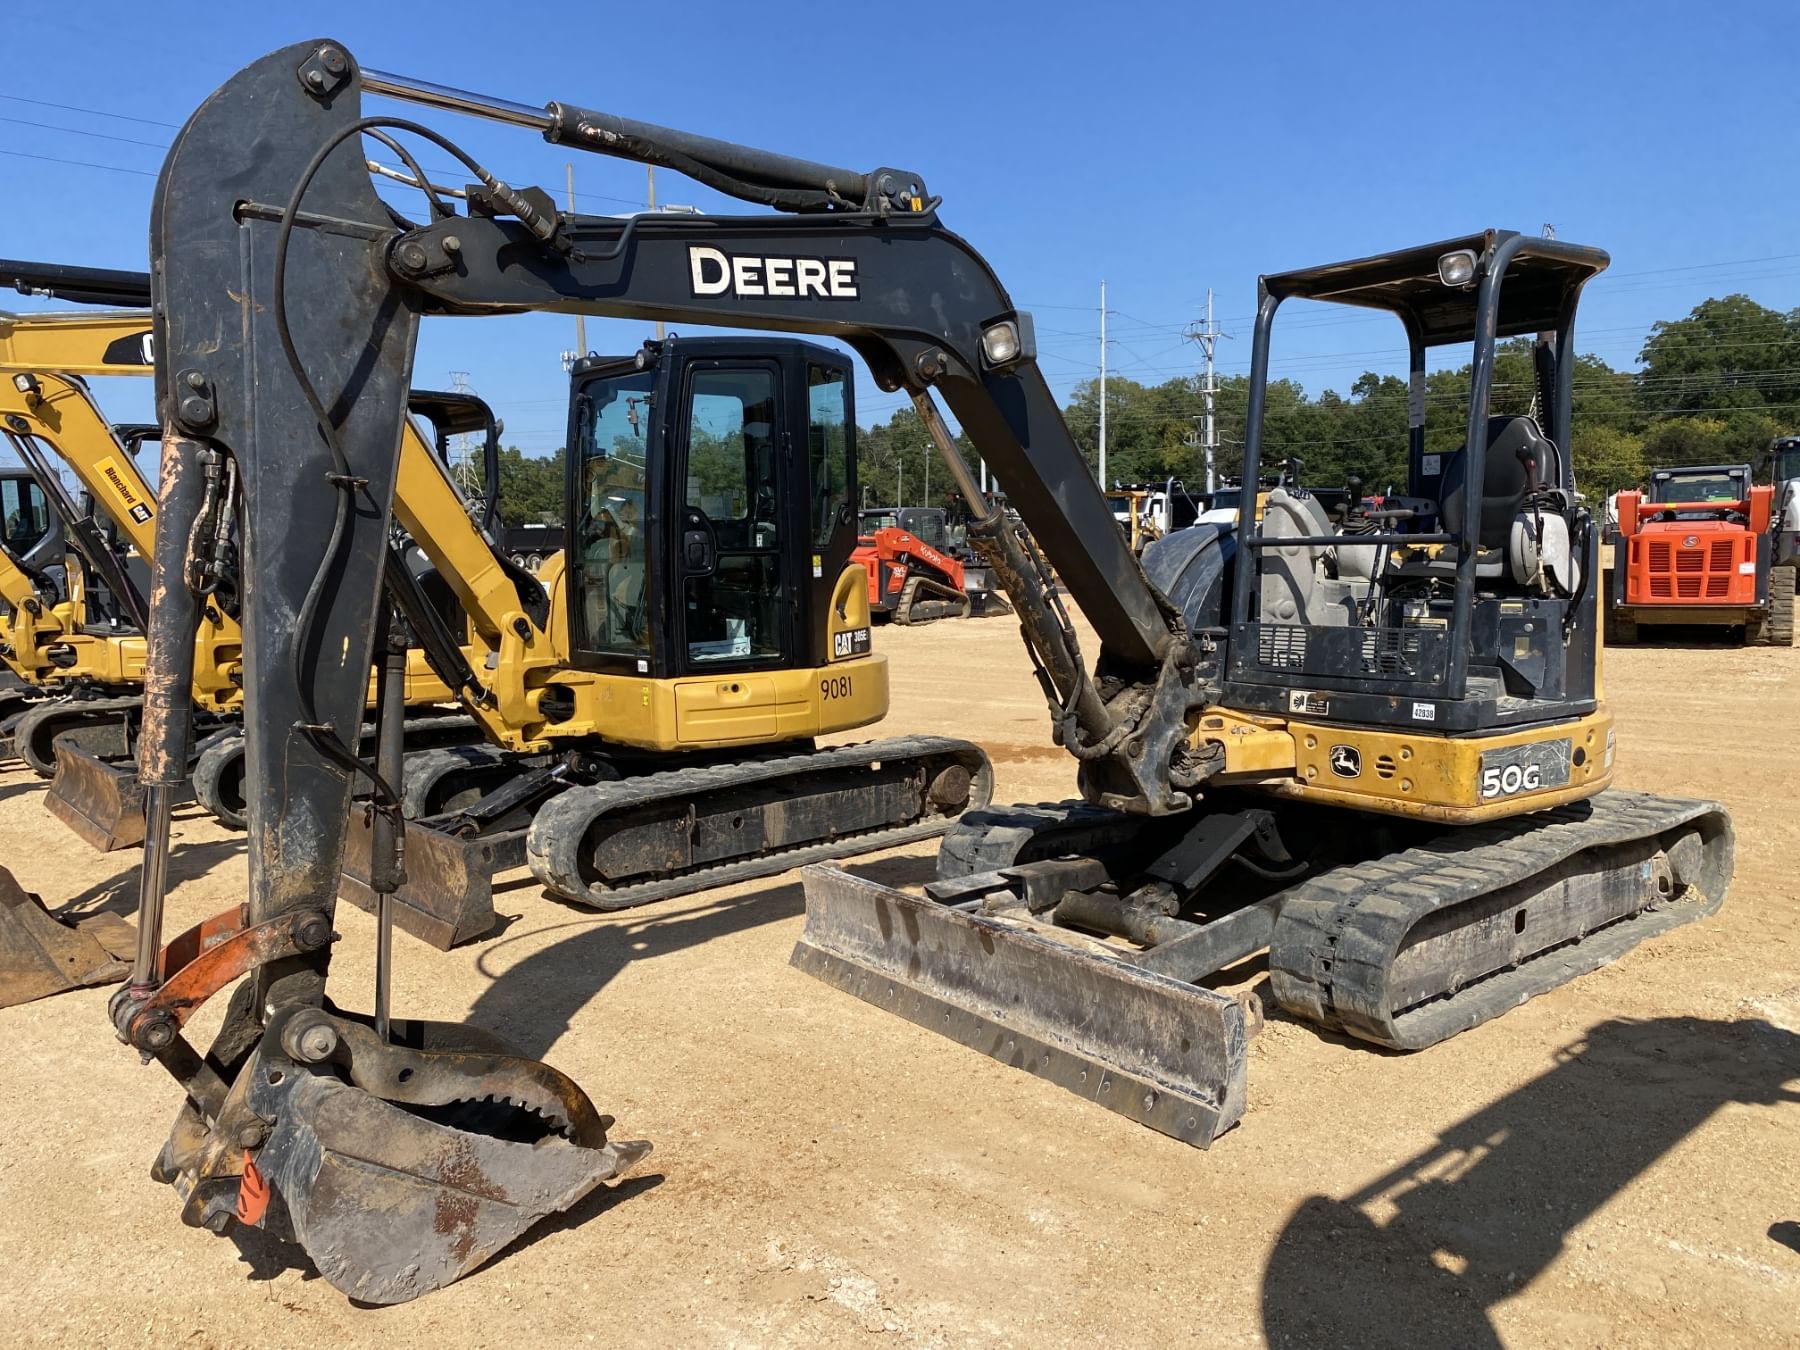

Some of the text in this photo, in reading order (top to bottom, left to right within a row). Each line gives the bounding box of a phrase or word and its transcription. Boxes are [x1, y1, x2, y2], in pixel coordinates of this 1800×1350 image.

[689, 246, 857, 297] DEERE
[105, 467, 136, 504] Blanchard
[132, 505, 150, 521] CAT
[835, 632, 852, 656] CAT
[821, 676, 852, 700] 9081
[1482, 765, 1540, 798] 50G
